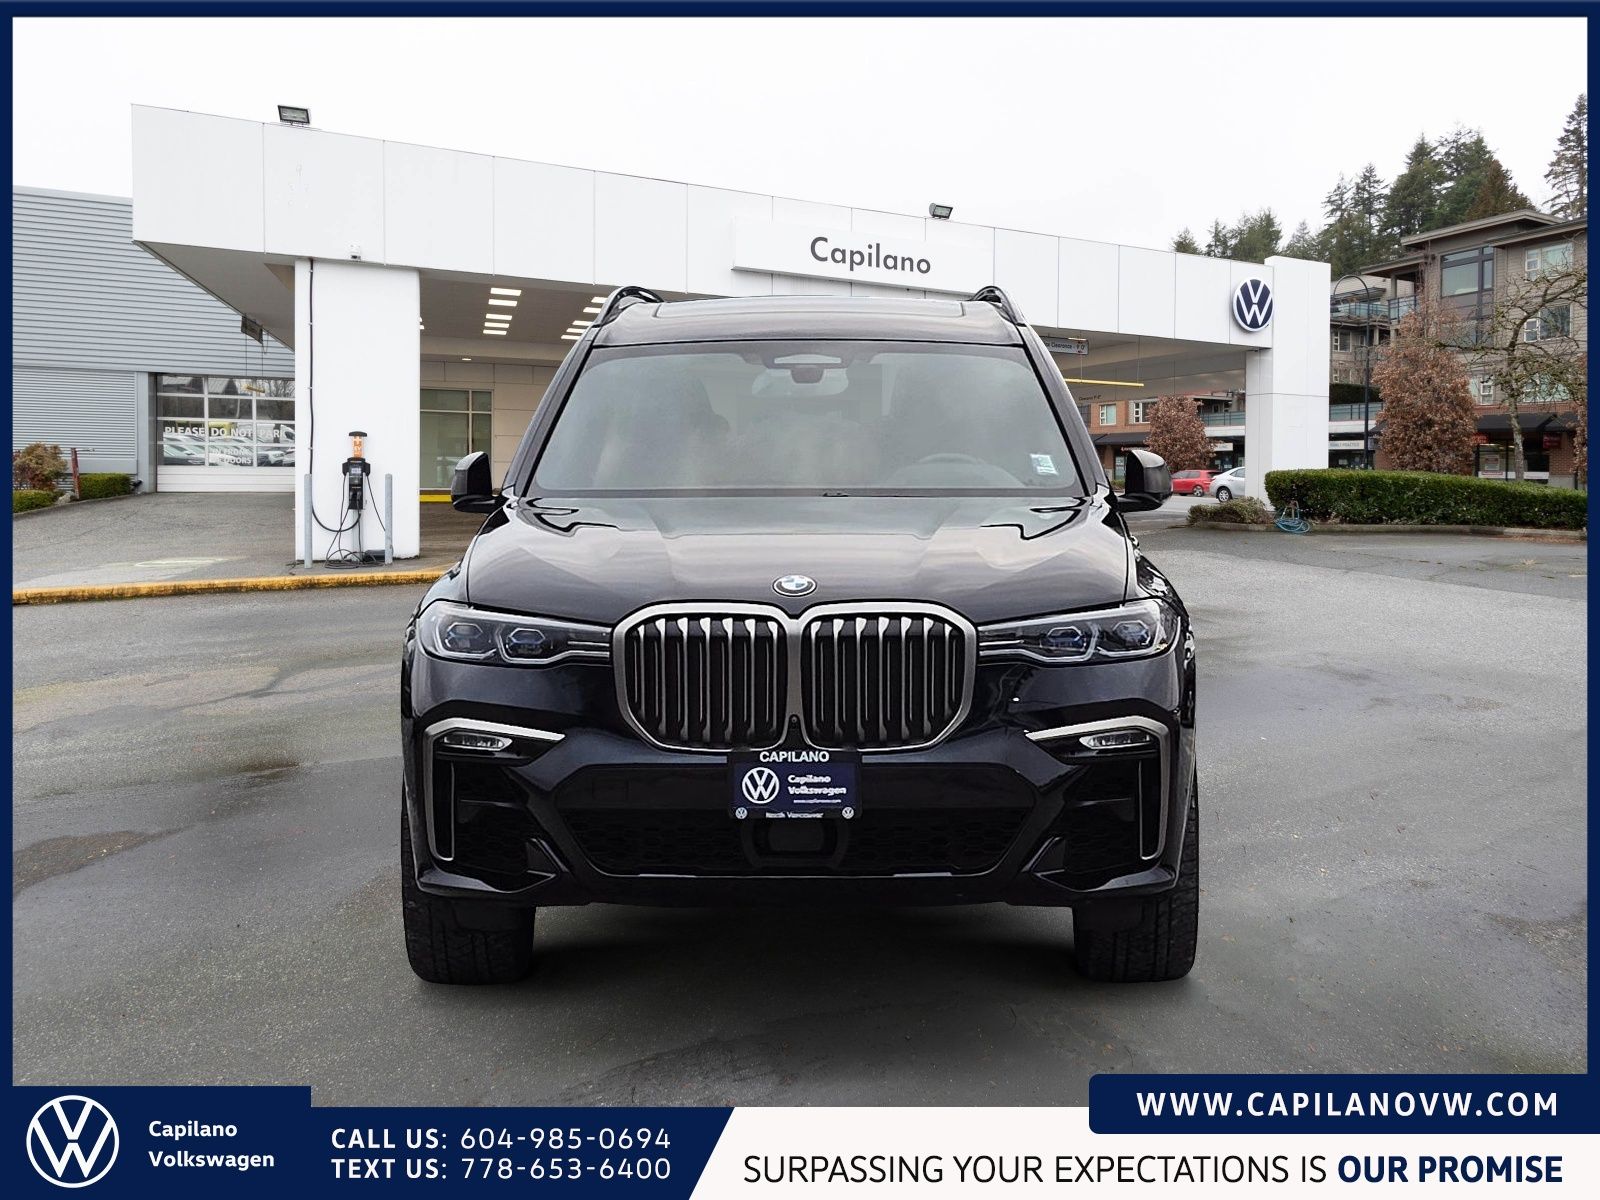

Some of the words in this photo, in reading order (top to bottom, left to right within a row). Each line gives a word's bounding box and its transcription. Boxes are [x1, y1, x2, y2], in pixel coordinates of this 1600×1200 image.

[810, 236, 931, 274] Capilano
[164, 426, 205, 436] PLEASE
[211, 427, 227, 437] DO
[231, 428, 253, 438] NOT
[223, 456, 252, 464] DOORS
[759, 751, 830, 762] CAPILANO
[787, 774, 831, 785] Capilano
[787, 786, 847, 796] Volkswagen
